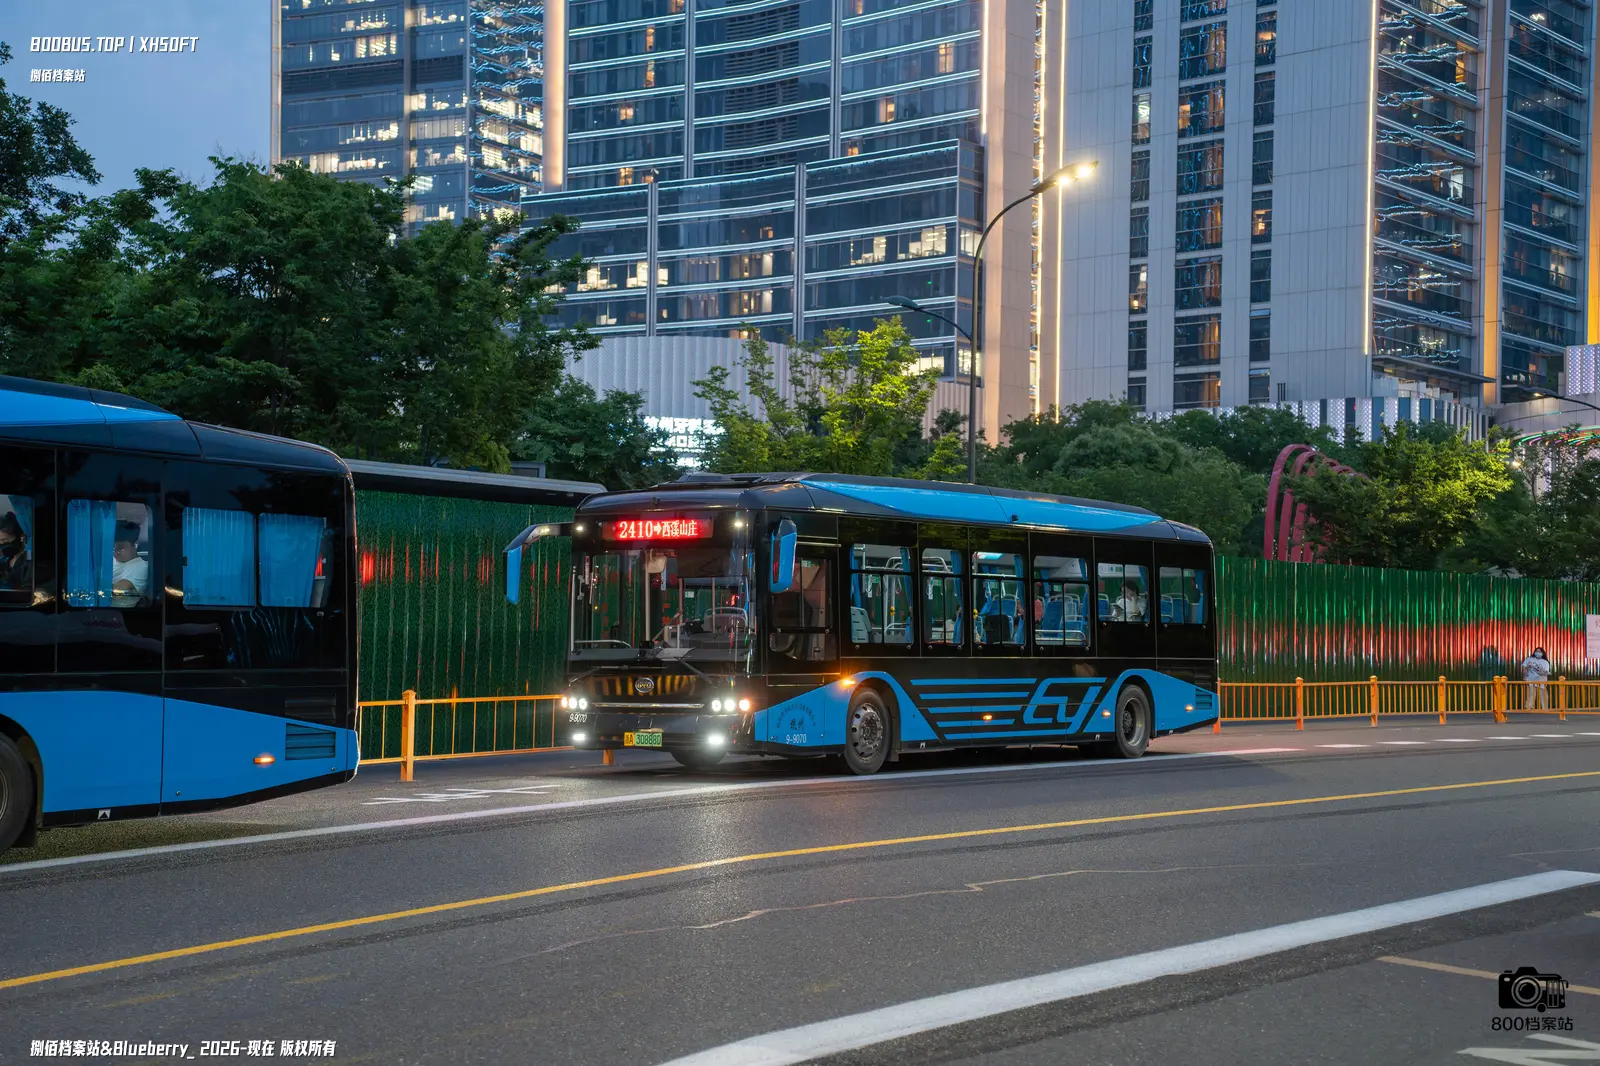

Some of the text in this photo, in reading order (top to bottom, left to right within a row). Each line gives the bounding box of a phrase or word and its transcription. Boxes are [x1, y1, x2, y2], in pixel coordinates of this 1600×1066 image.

[619, 519, 698, 539] 2410 西溪山庄
[785, 733, 807, 745] 9-9070
